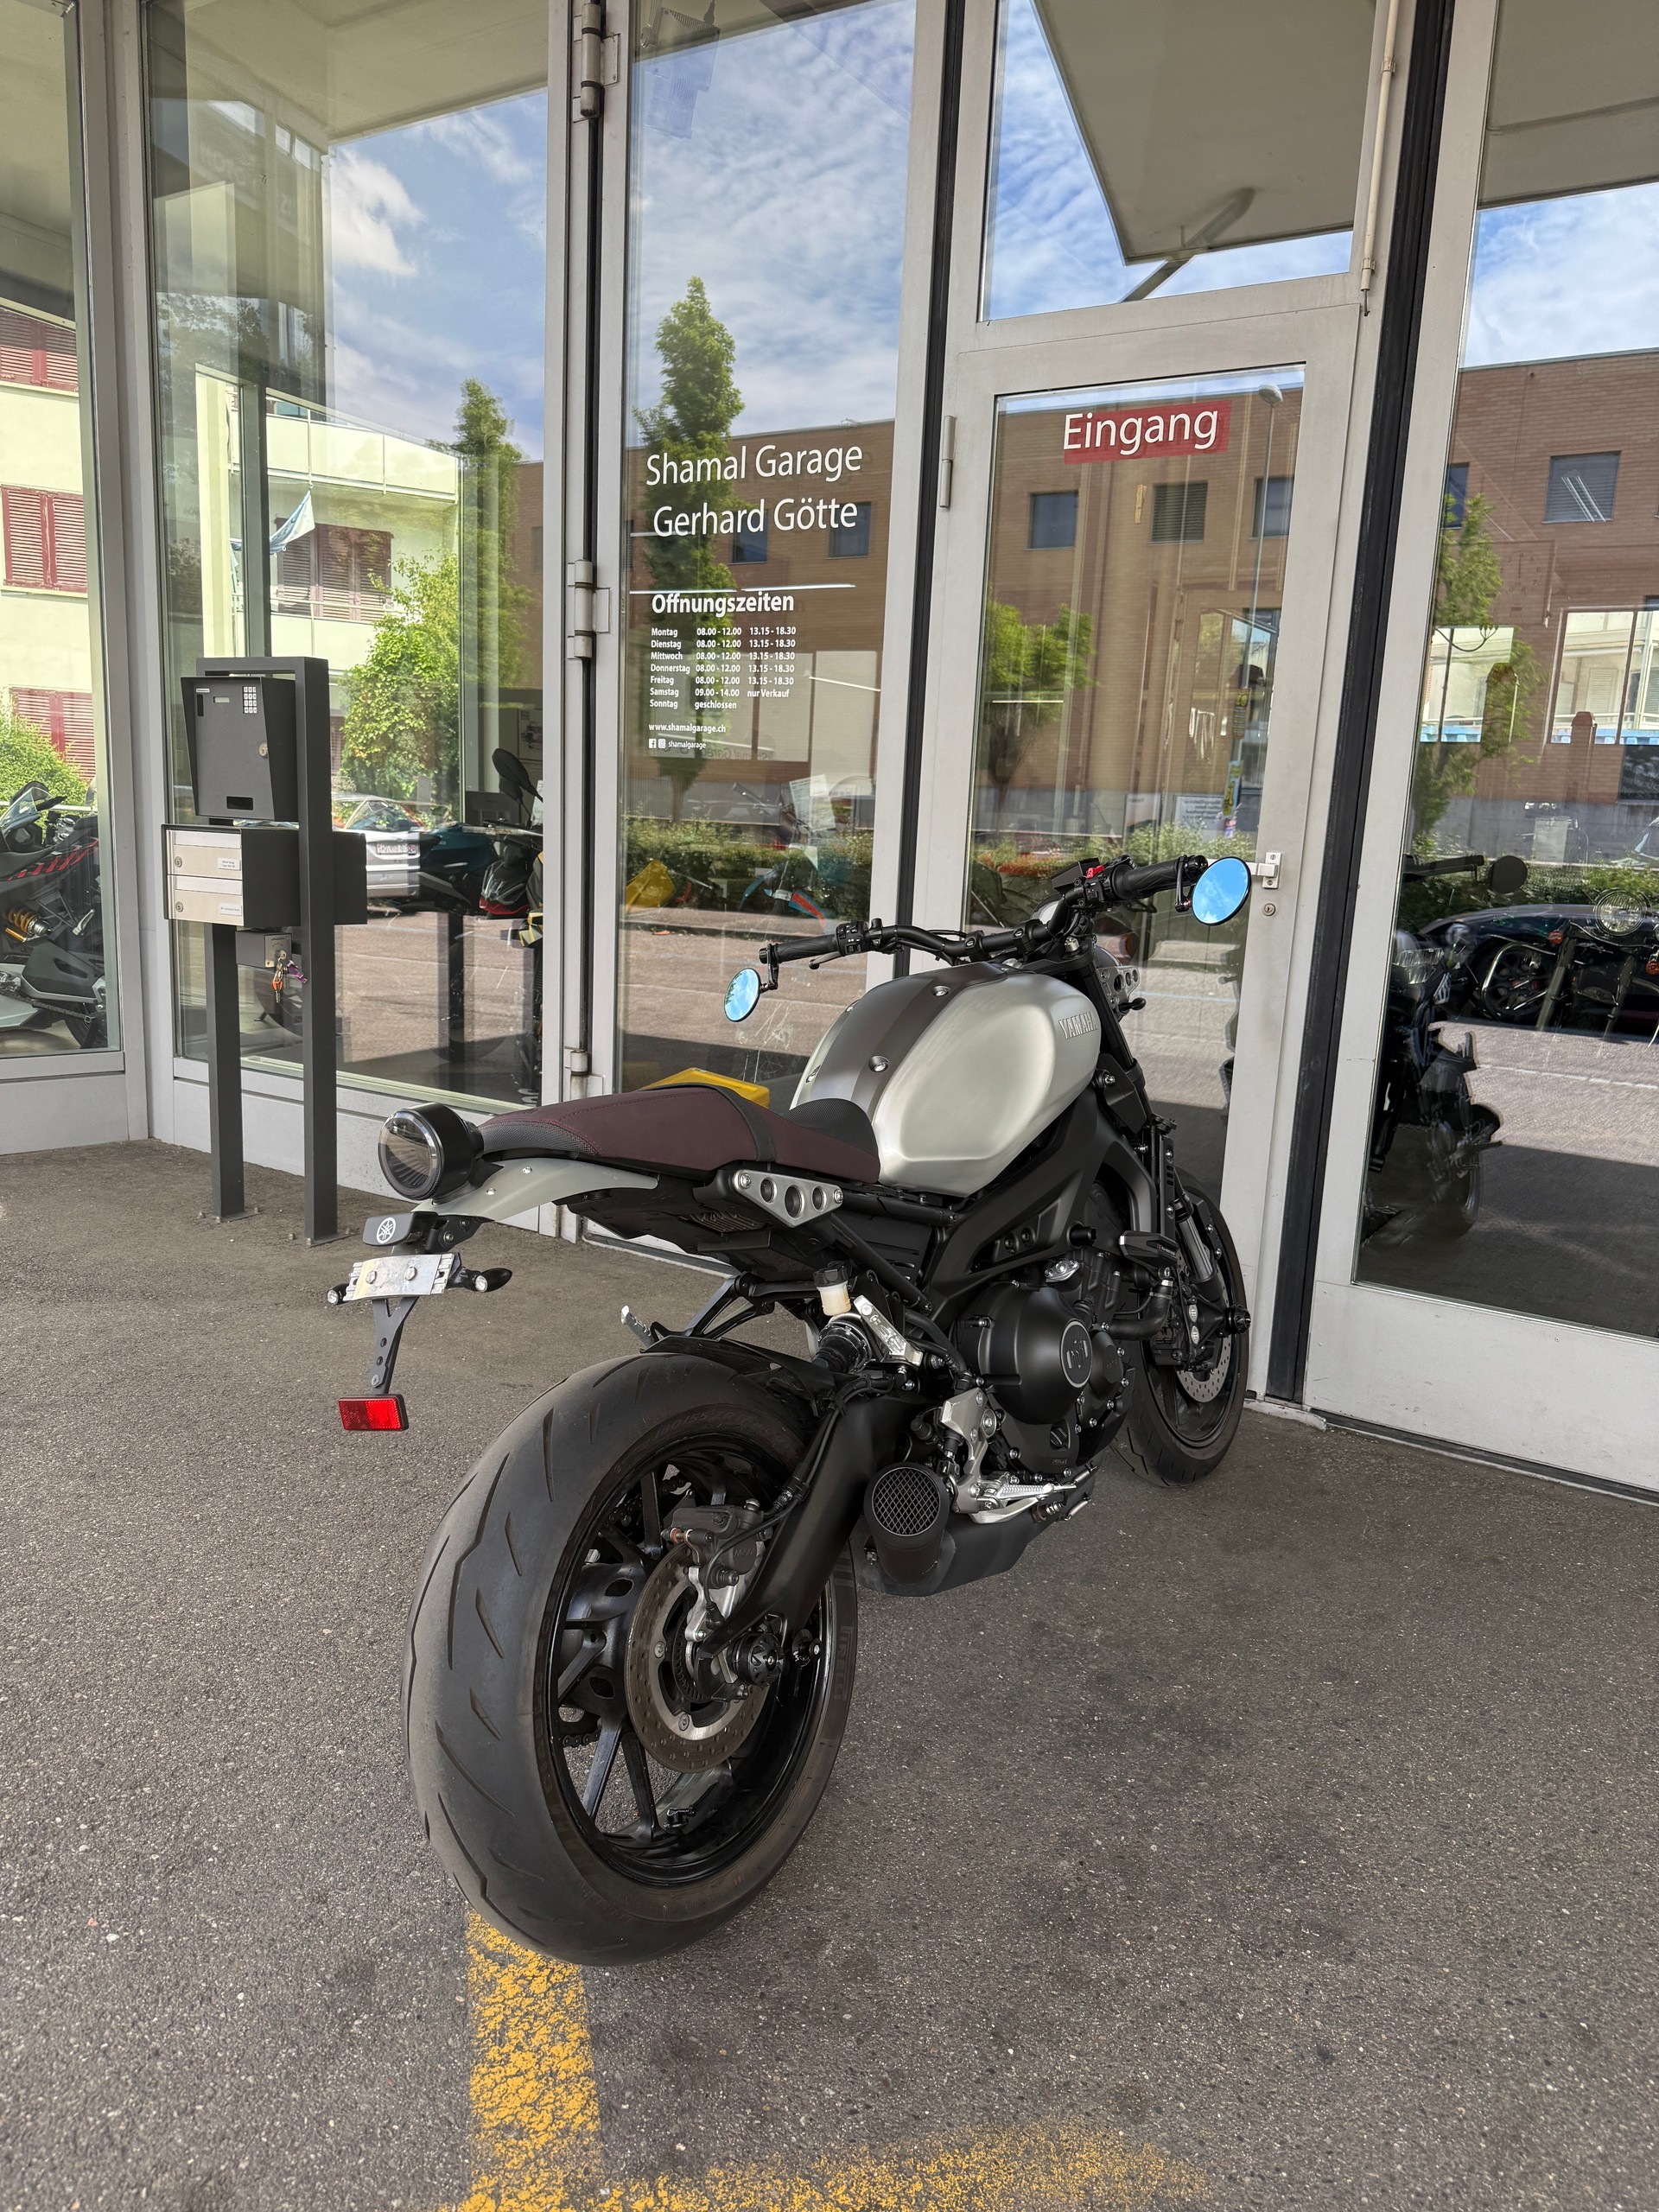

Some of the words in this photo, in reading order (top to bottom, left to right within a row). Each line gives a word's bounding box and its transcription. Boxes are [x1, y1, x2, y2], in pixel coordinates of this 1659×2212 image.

[1064, 411, 1217, 454] Eingang
[646, 445, 746, 485] Shamal
[756, 445, 861, 481] Garage
[654, 499, 764, 537] Gerhard
[774, 498, 857, 531] Götte
[652, 628, 677, 638] Montag
[652, 640, 681, 650] Dienstag
[651, 664, 690, 674] Donnerstag
[651, 676, 674, 685] Freitag
[651, 688, 678, 697] Samstag
[761, 689, 789, 697] Verkauf
[650, 699, 677, 709] Sonntag
[695, 700, 736, 709] geschlossen
[649, 723, 726, 734] www.shamalgarage.ch
[668, 741, 707, 749] shamalgarage
[1058, 1012, 1097, 1039] YAMAHA
